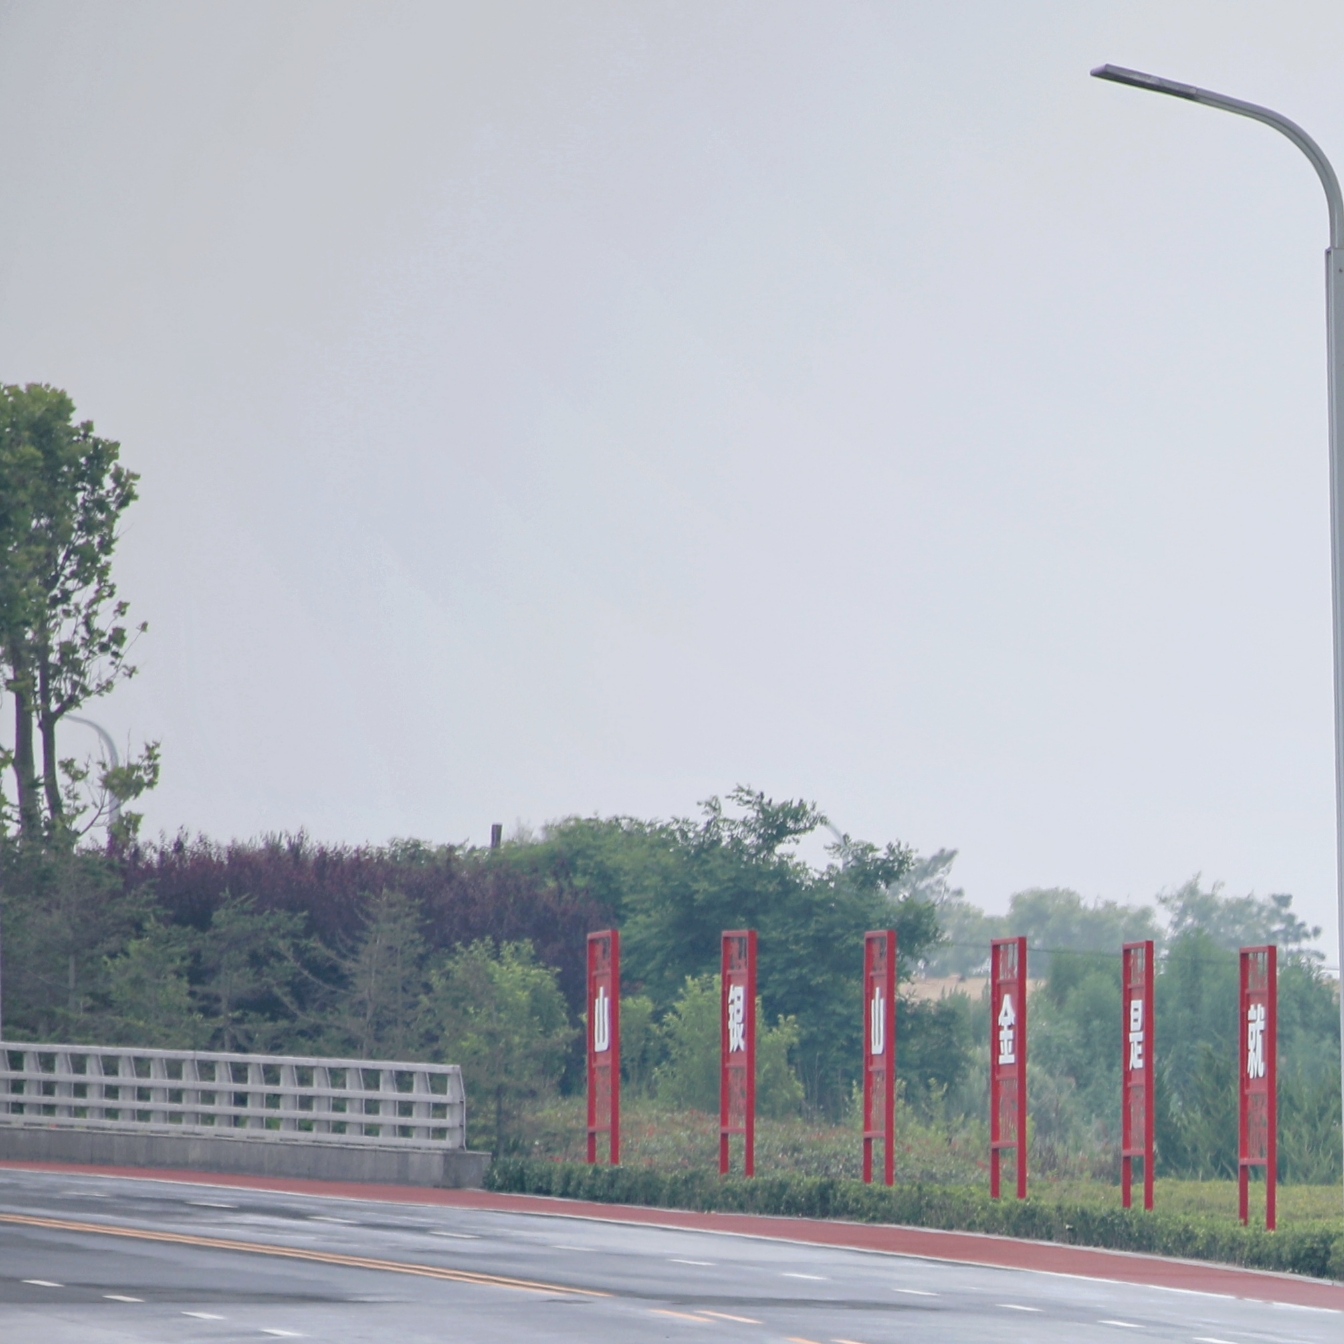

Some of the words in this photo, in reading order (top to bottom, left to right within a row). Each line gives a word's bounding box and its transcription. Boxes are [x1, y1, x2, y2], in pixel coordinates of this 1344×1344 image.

[595, 986, 608, 1052] 山
[728, 984, 745, 1053] 银
[872, 986, 883, 1055] 山
[999, 993, 1016, 1065] 金
[1129, 999, 1143, 1070] 是
[1248, 1003, 1264, 1079] 就
